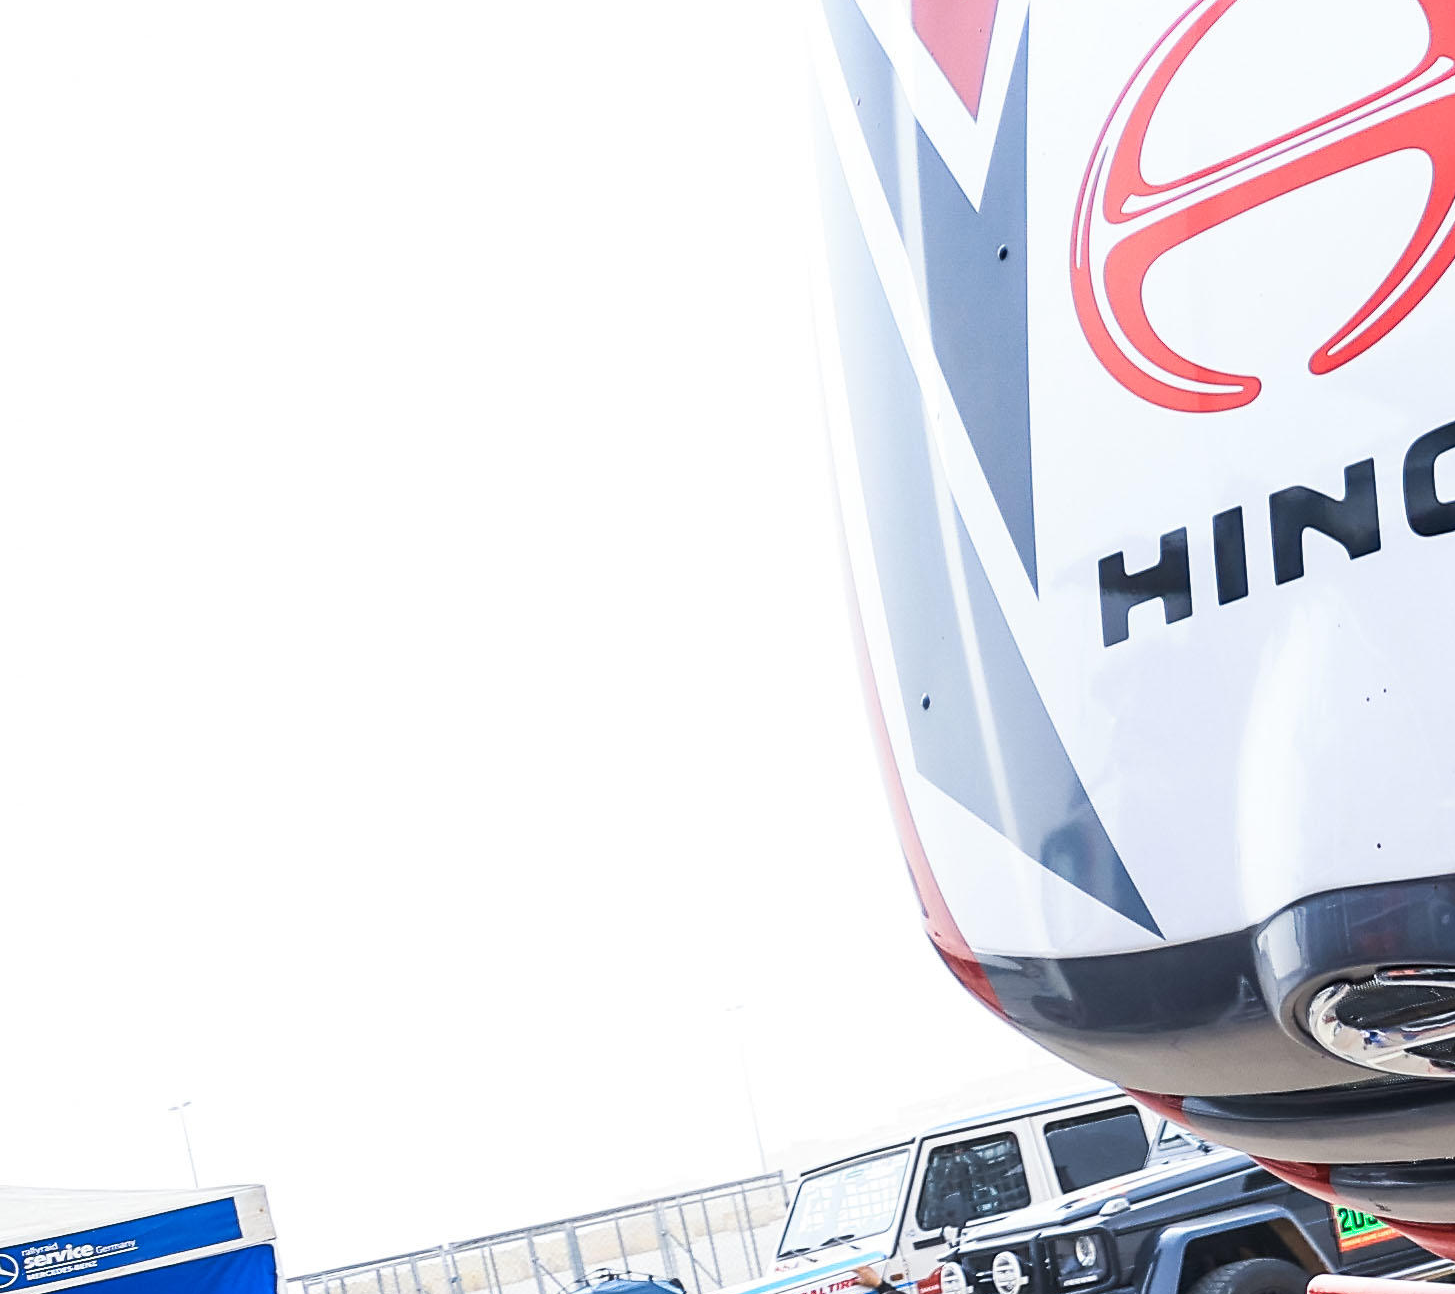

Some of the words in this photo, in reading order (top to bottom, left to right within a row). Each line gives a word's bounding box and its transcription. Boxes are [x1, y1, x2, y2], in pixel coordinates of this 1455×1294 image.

[21, 1241, 59, 1257] rallyraid
[24, 1244, 95, 1270] service
[95, 1239, 136, 1255] Germany
[26, 1260, 98, 1281] MERCEDES-BENZ
